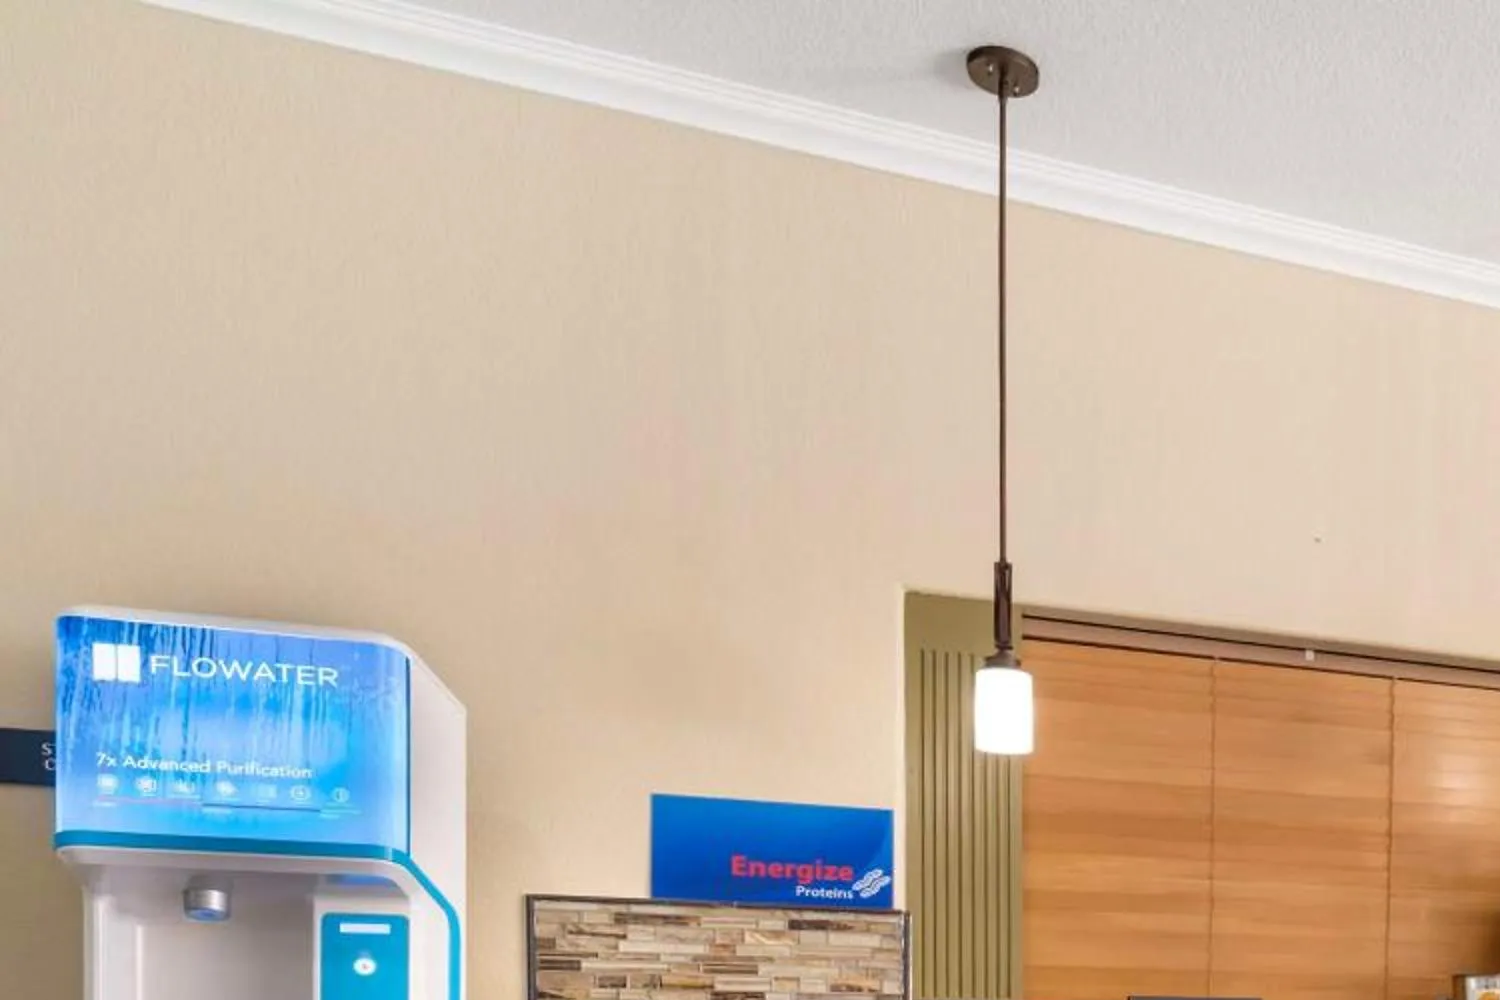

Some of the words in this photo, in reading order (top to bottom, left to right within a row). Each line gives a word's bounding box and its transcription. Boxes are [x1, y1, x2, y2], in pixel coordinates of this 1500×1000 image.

[151, 654, 339, 688] FLOWATER
[96, 752, 118, 768] 7x
[122, 754, 211, 774] Advanced
[216, 758, 313, 779] Purification
[731, 854, 854, 885] Energize
[795, 885, 854, 900] Proteins
